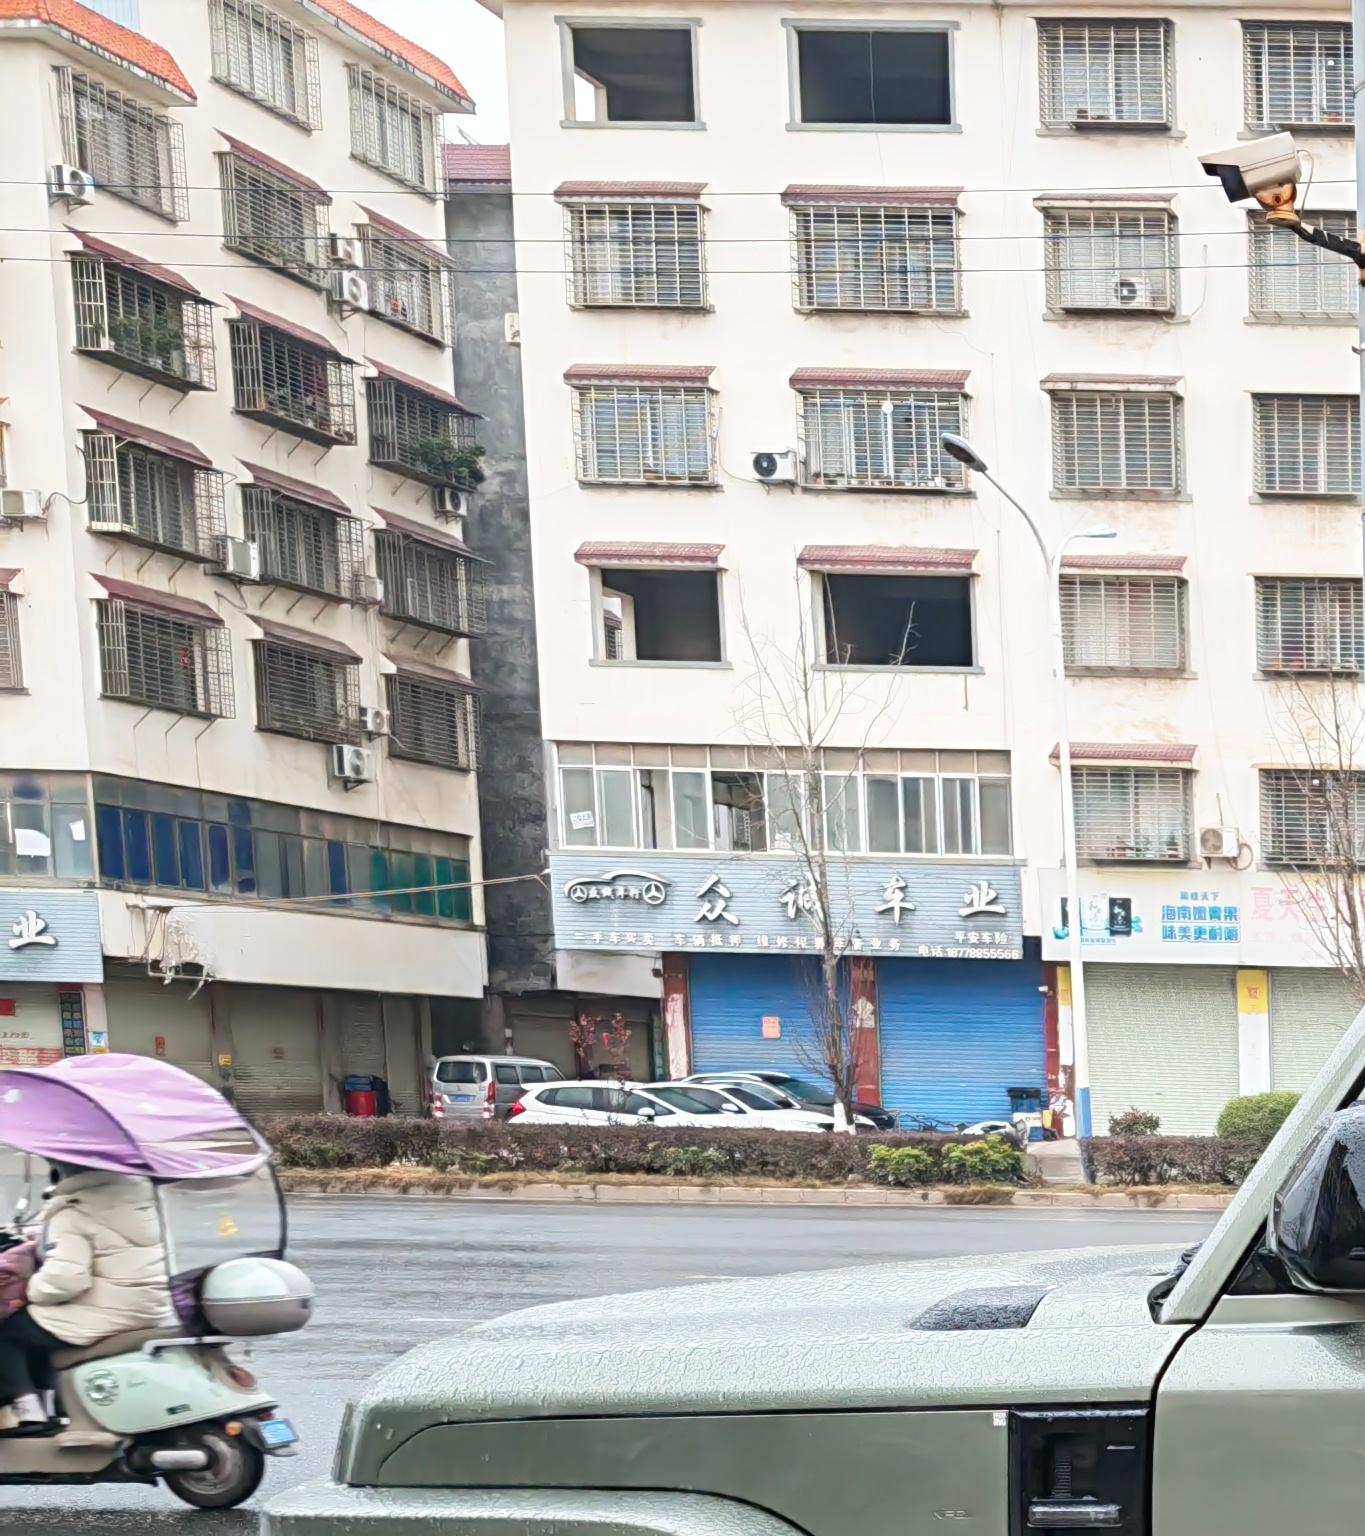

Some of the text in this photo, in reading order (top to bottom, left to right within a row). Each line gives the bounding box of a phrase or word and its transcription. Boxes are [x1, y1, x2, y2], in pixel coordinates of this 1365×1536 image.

[8, 910, 57, 949] 业
[573, 931, 655, 946] 二手车买卖
[954, 931, 1009, 945] 平安车险
